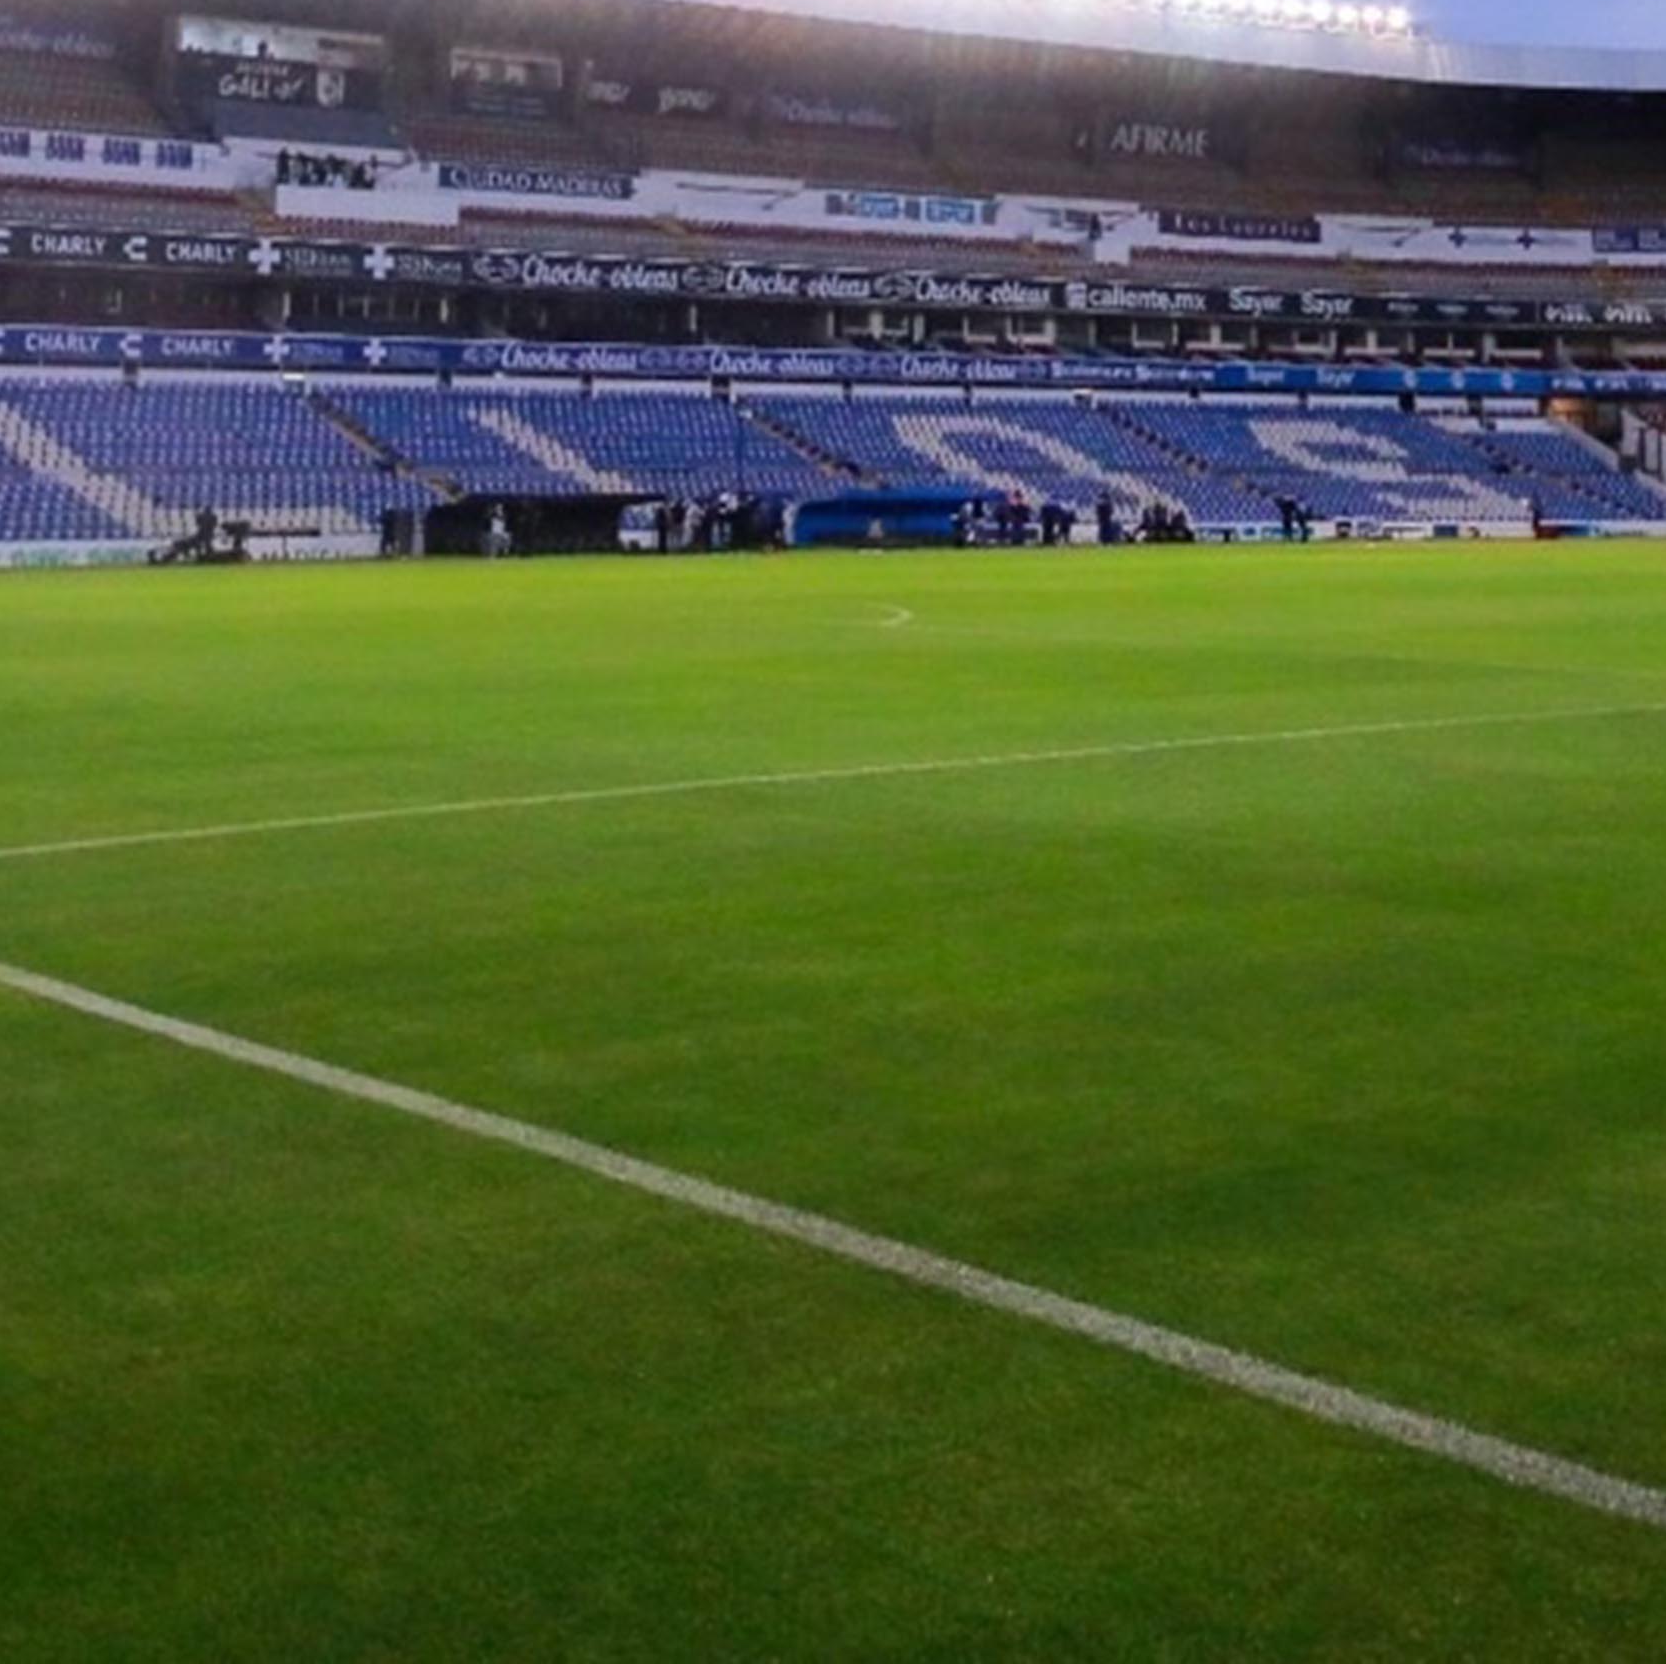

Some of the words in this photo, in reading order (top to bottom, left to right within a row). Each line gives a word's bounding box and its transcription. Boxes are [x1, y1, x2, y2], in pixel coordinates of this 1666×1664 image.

[1109, 122, 1209, 158] AFIRME
[31, 234, 108, 259] CHARLY
[165, 240, 234, 266] CHARLY
[521, 254, 679, 293] Chocke-obleas
[725, 265, 871, 301] Chocke-obleas
[915, 274, 1052, 307] Chocke-obleas
[1088, 283, 1207, 313] caliente.mx
[1229, 287, 1284, 318] Sayer
[1300, 292, 1354, 321] Sayer
[24, 332, 101, 354] CHARLY
[161, 335, 234, 358] CHARLY
